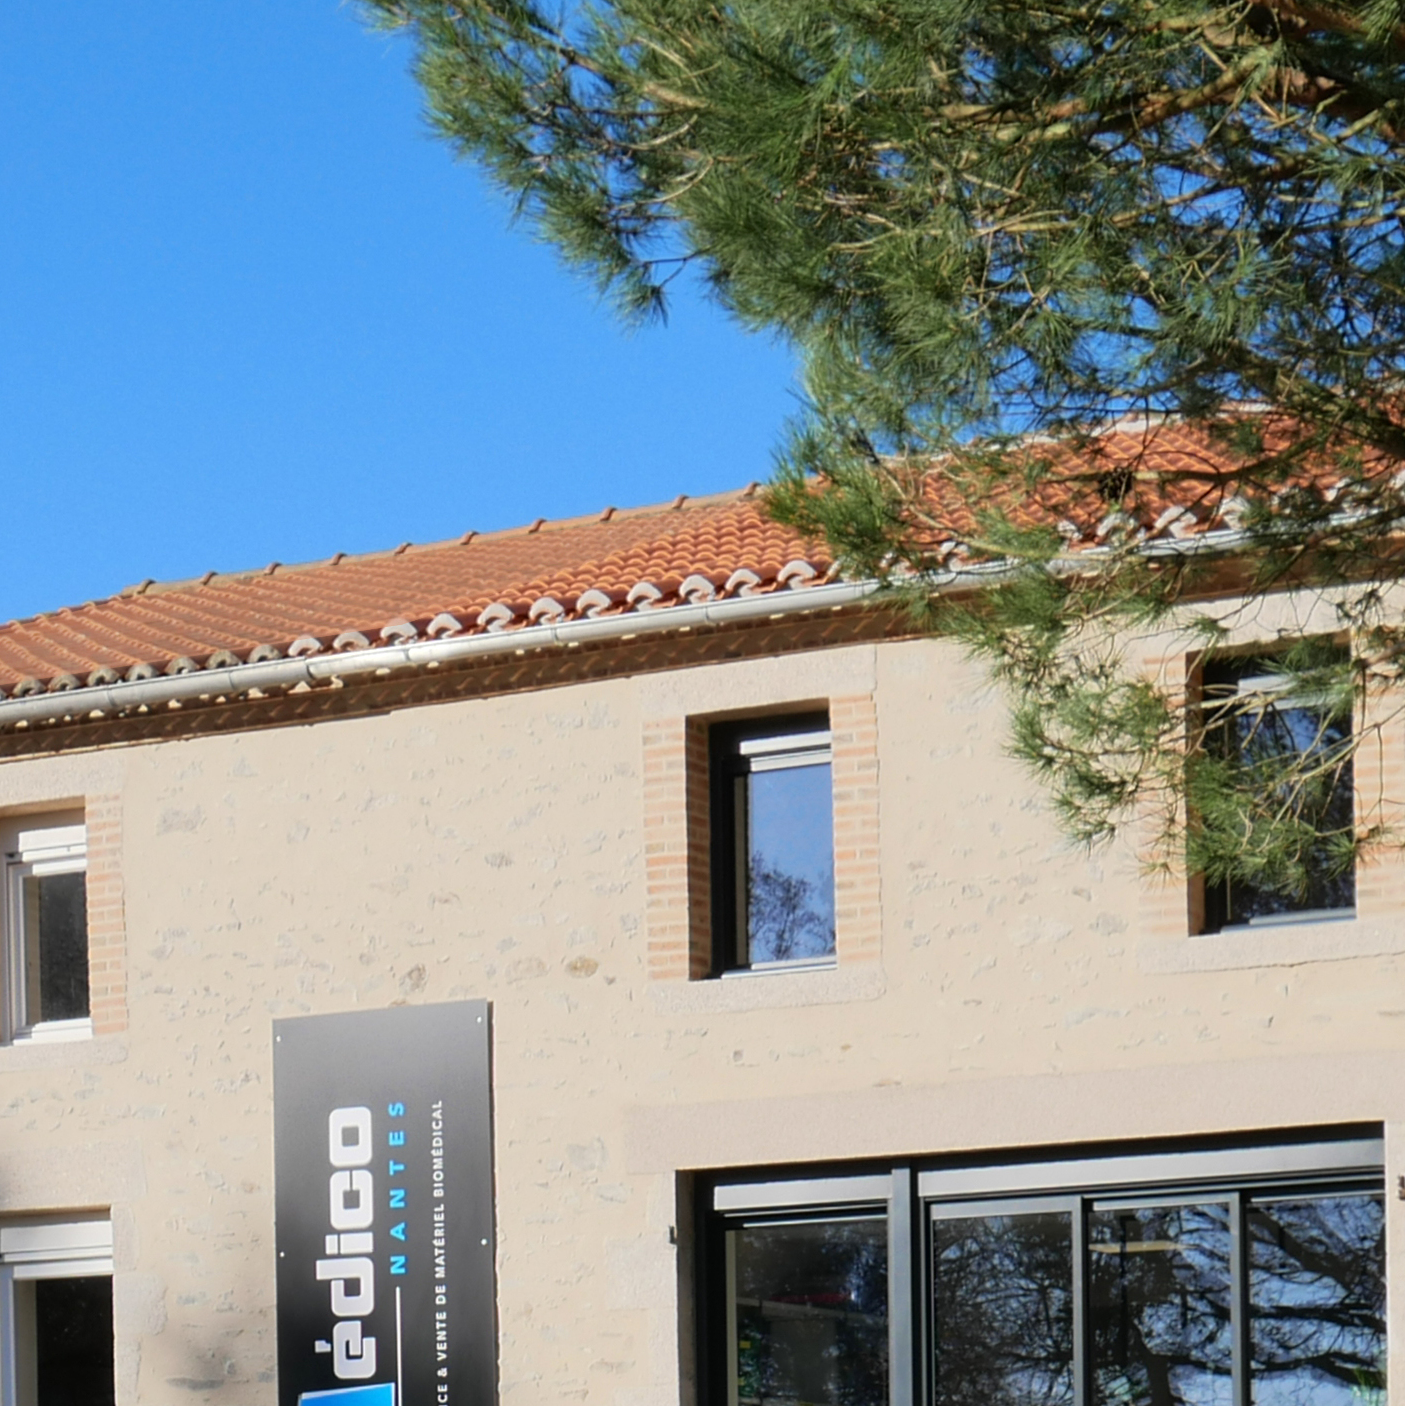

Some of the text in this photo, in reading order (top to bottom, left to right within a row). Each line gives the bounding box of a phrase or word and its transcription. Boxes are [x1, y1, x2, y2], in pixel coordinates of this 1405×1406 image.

[430, 1100, 445, 1198] BIOMÉDICAL
[388, 1101, 406, 1275] NANTES
[432, 1203, 446, 1278] MATÉRIEL
[434, 1285, 447, 1305] DE
[435, 1311, 448, 1361] VENTE
[439, 1367, 448, 1378] &
